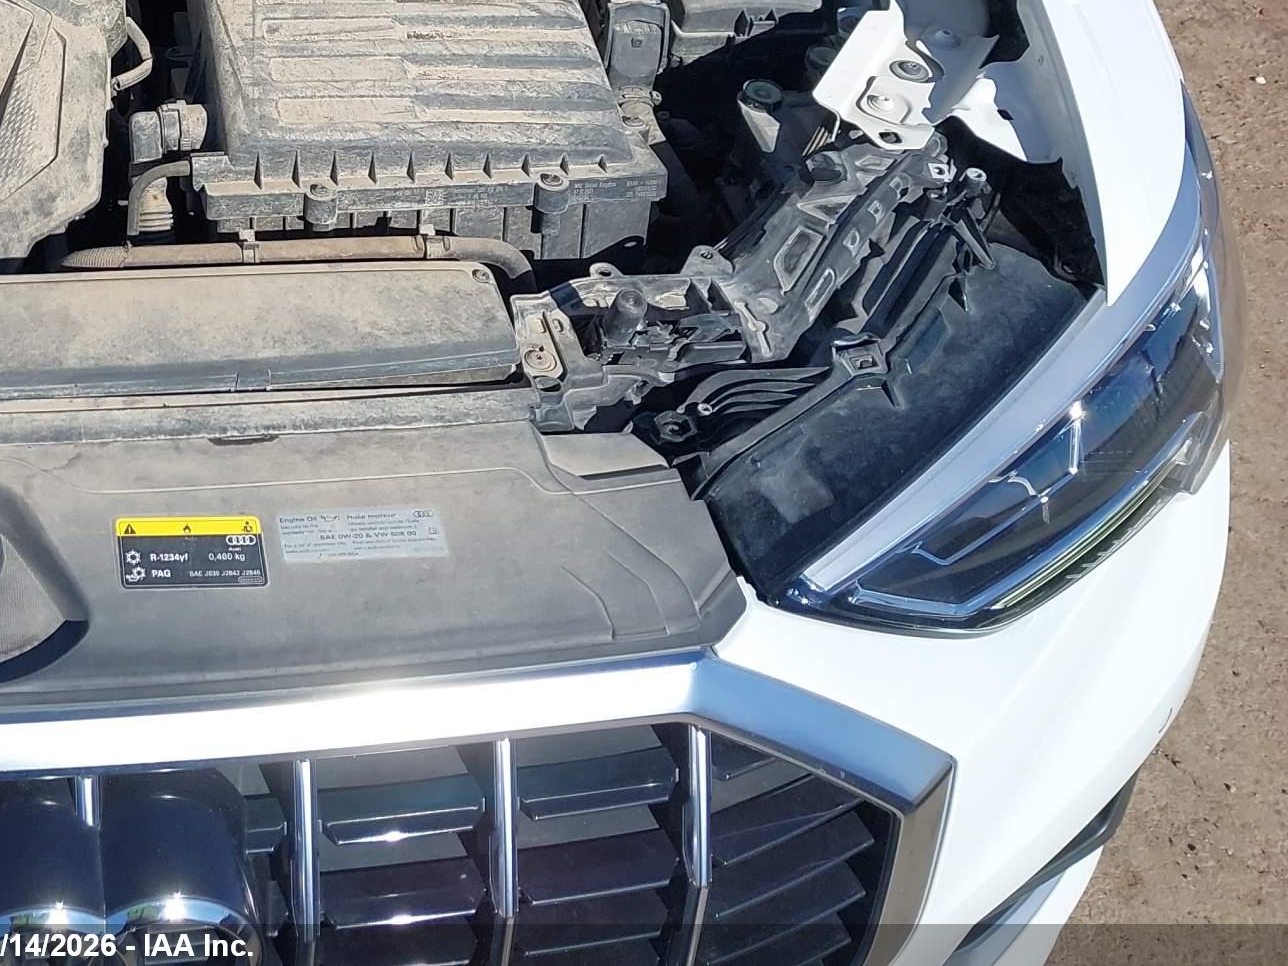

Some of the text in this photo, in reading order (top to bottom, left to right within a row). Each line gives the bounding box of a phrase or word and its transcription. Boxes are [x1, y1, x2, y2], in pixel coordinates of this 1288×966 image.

[150, 553, 189, 562] R-1234yf
[235, 552, 246, 562] kg
[152, 569, 172, 578] PAG
